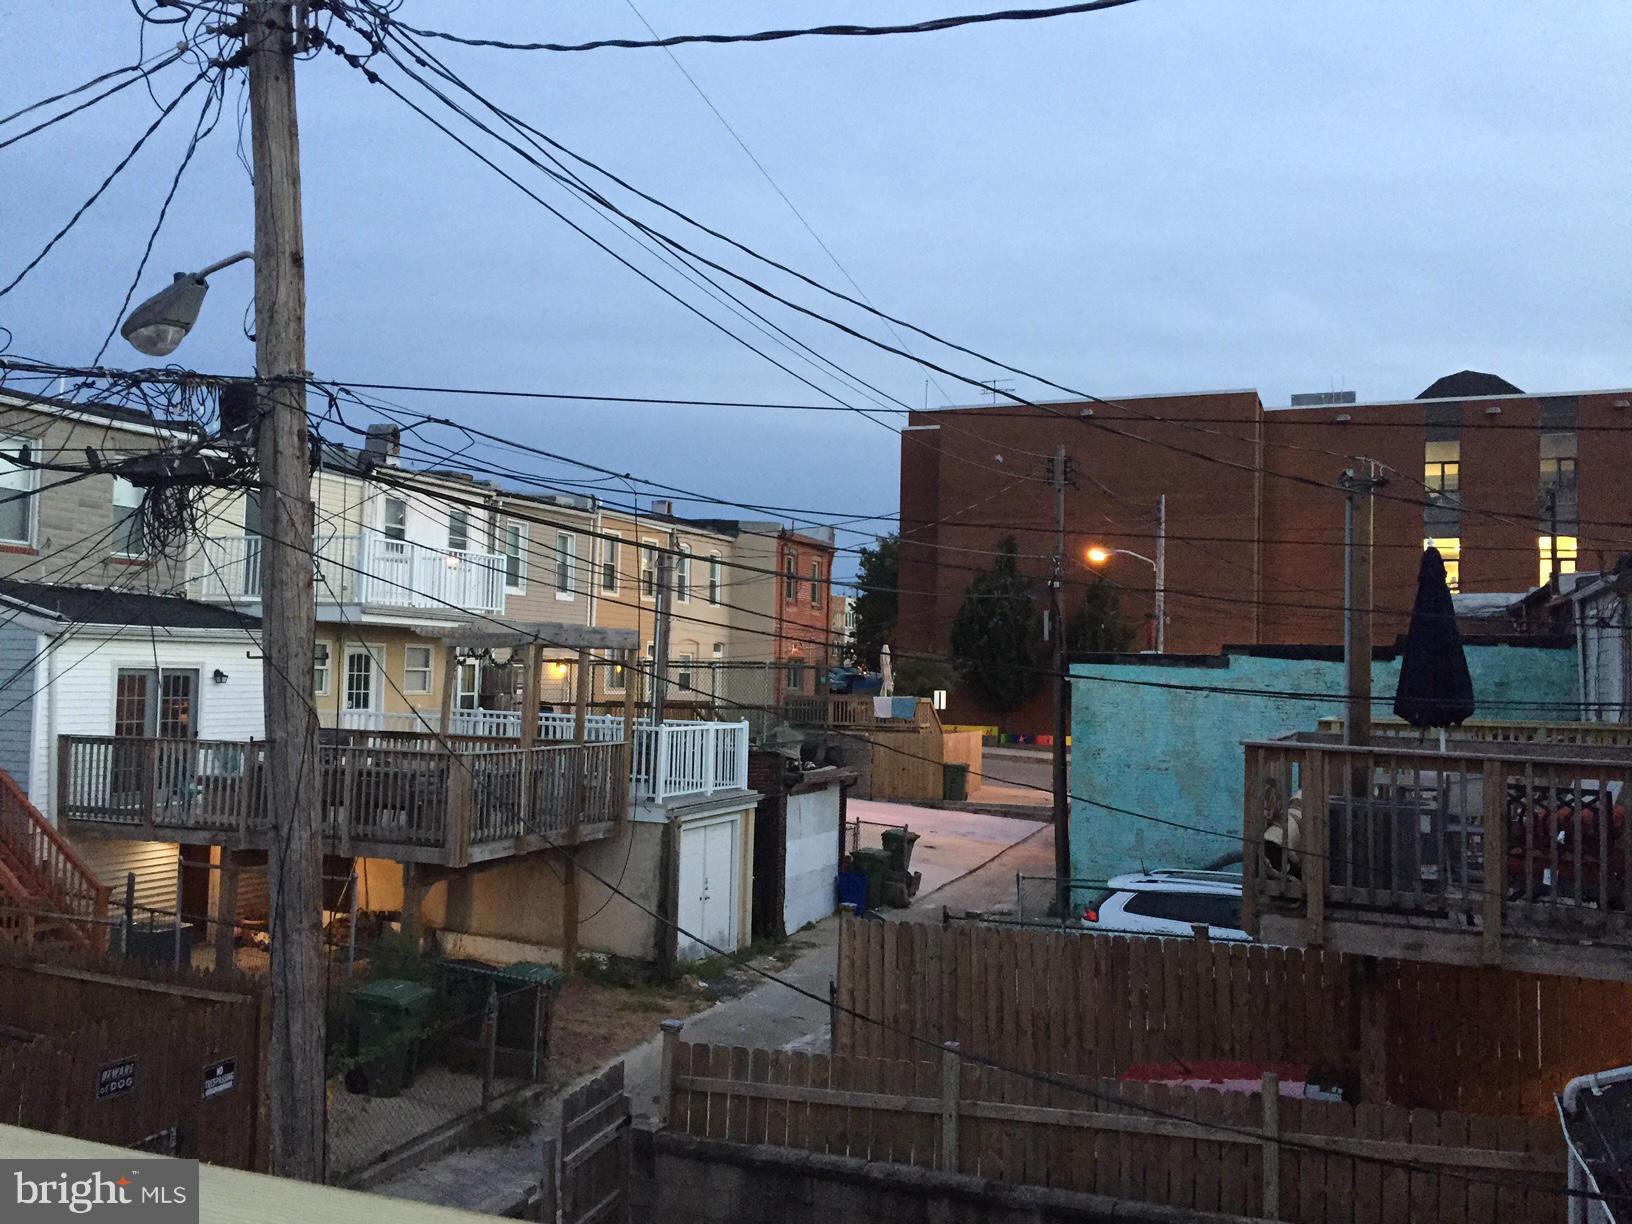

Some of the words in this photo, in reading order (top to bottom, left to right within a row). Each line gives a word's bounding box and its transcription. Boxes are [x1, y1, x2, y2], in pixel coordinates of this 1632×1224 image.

[101, 1063, 134, 1083] BEWARE
[216, 1065, 224, 1076] NO
[110, 1077, 133, 1091] DOG
